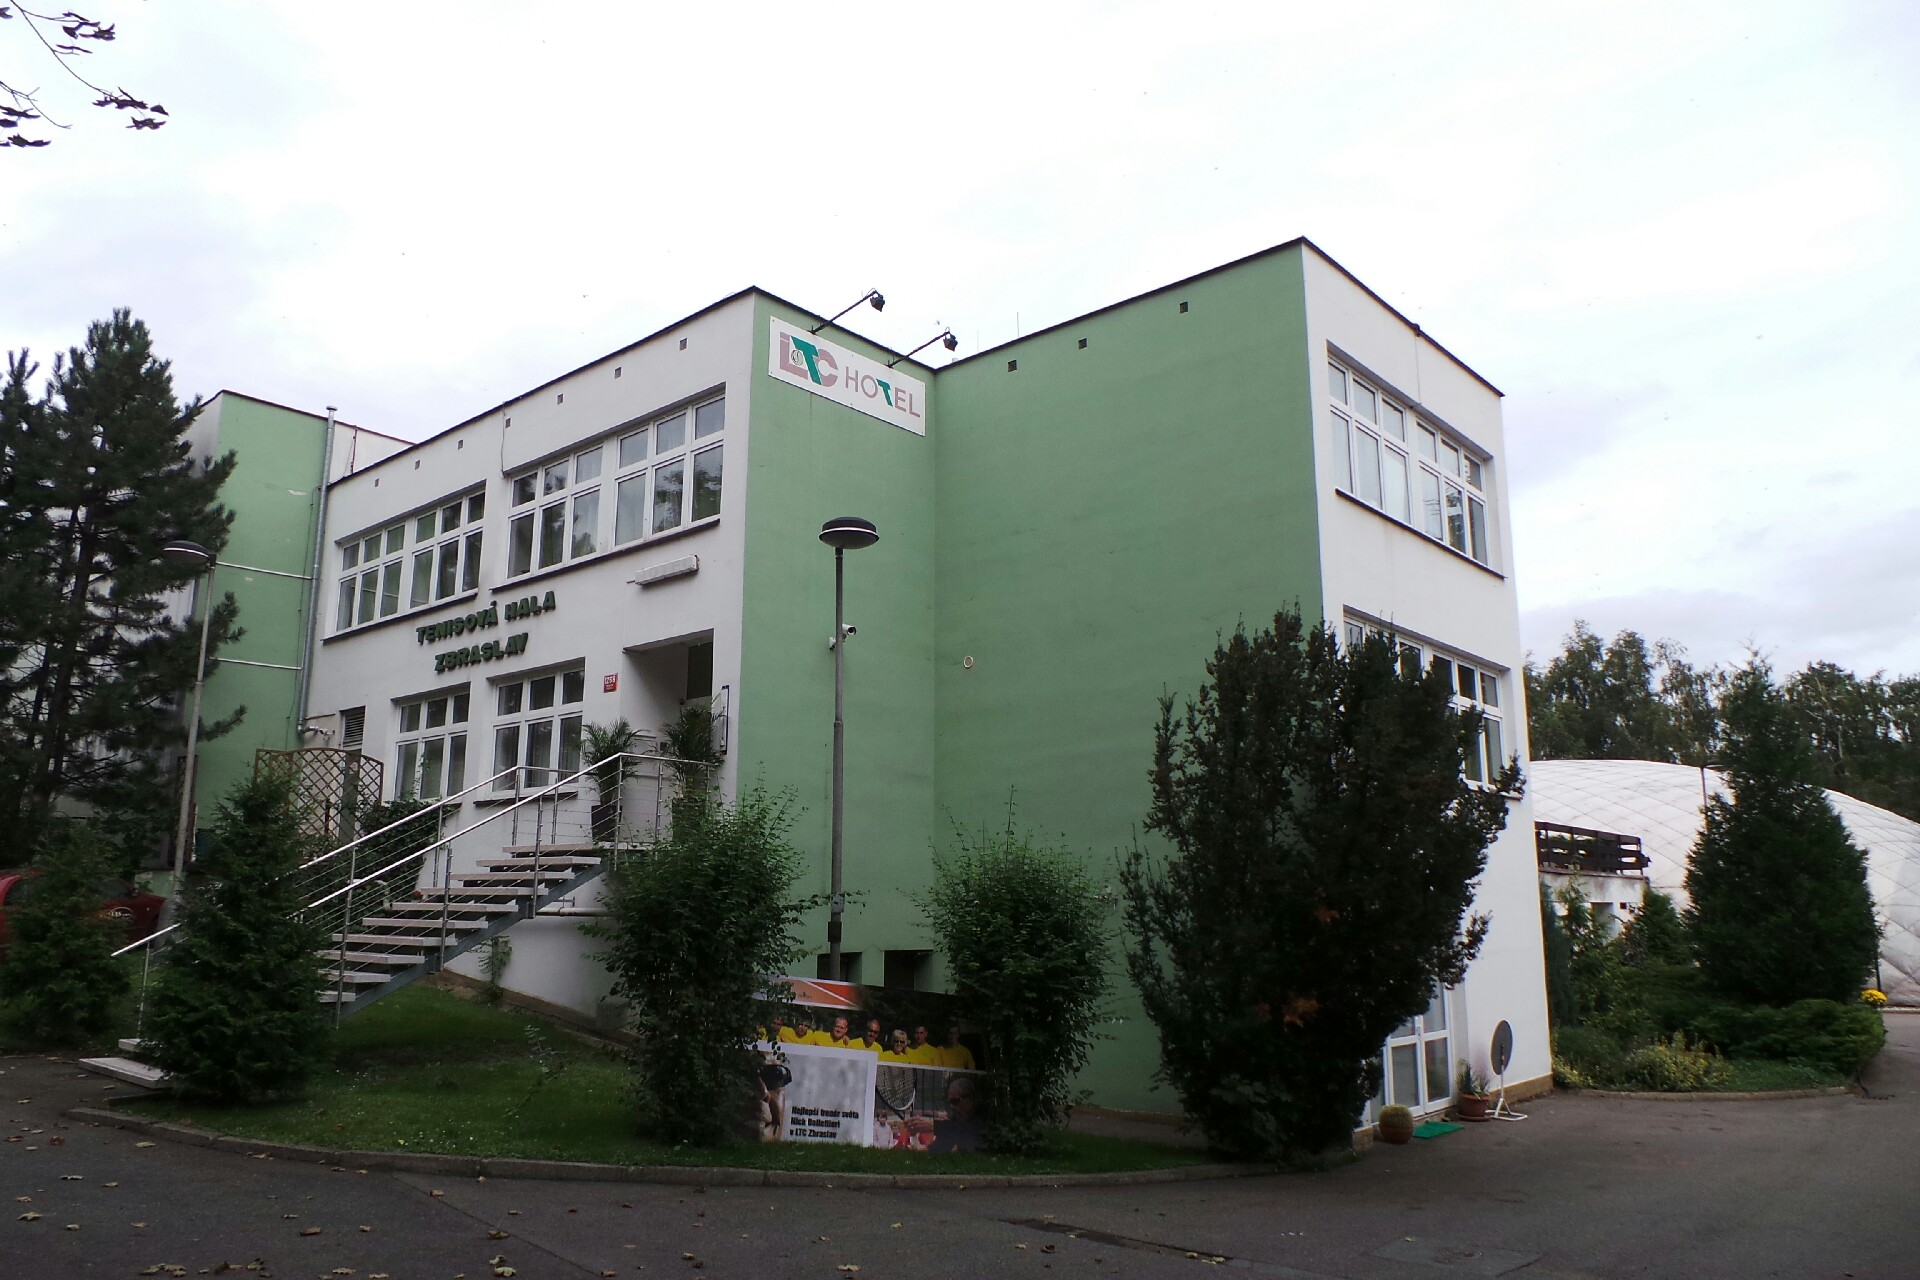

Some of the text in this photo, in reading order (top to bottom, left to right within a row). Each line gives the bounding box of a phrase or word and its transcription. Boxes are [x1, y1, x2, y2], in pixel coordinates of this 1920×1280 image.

[779, 331, 921, 418] LTC HOTEL
[416, 590, 556, 646] TENISOVÁ HALA
[434, 632, 529, 675] ZBRASLAV
[795, 1128, 806, 1136] LTC
[808, 1129, 837, 1138] Zbraslav
